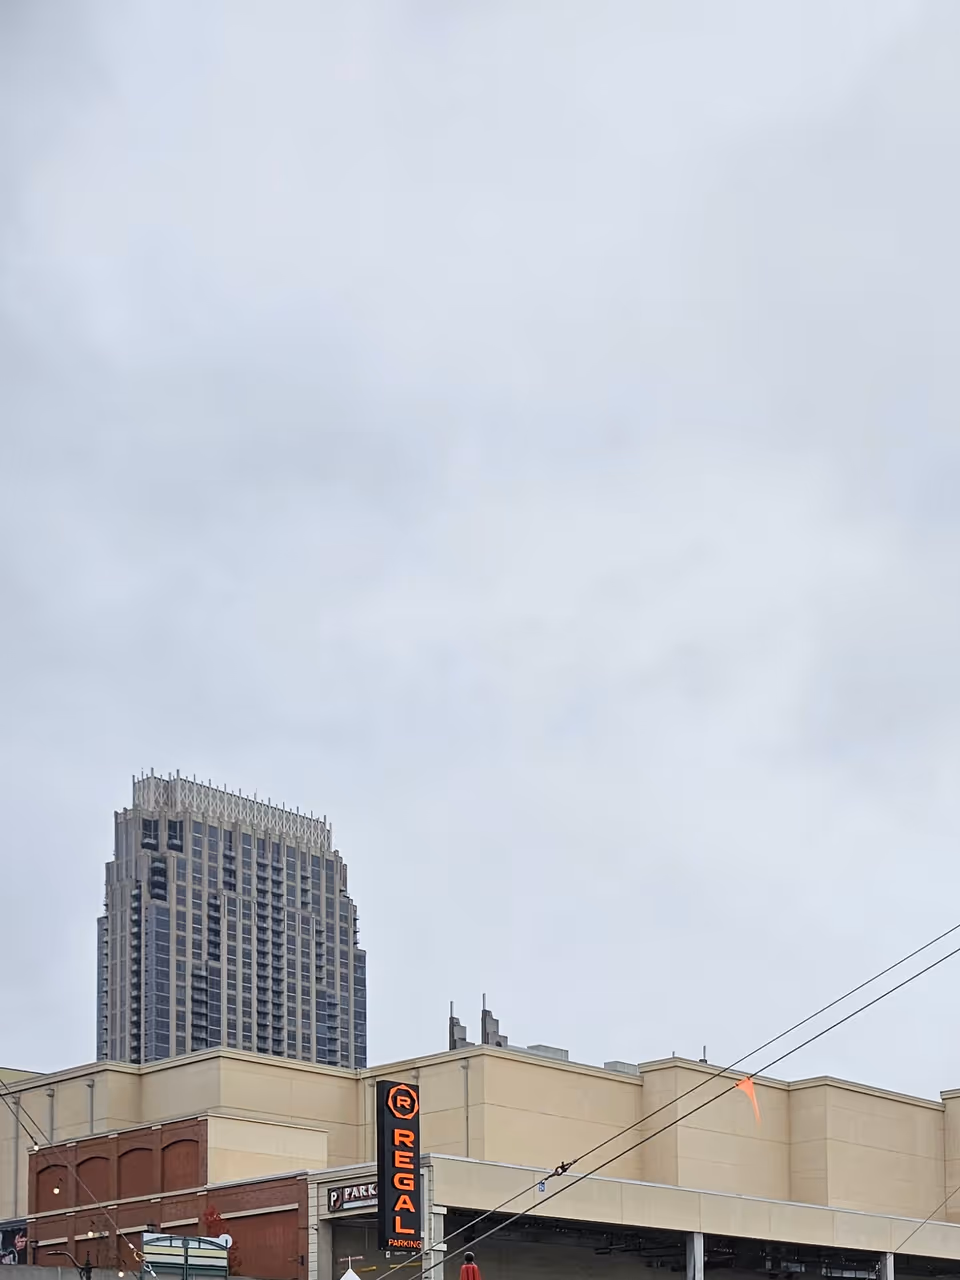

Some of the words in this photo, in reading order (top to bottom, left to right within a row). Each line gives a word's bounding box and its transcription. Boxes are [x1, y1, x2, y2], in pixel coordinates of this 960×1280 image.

[396, 1095, 411, 1109] R
[393, 1128, 415, 1234] REGAL
[345, 1184, 378, 1199] PARK
[388, 1238, 422, 1249] PARKING
